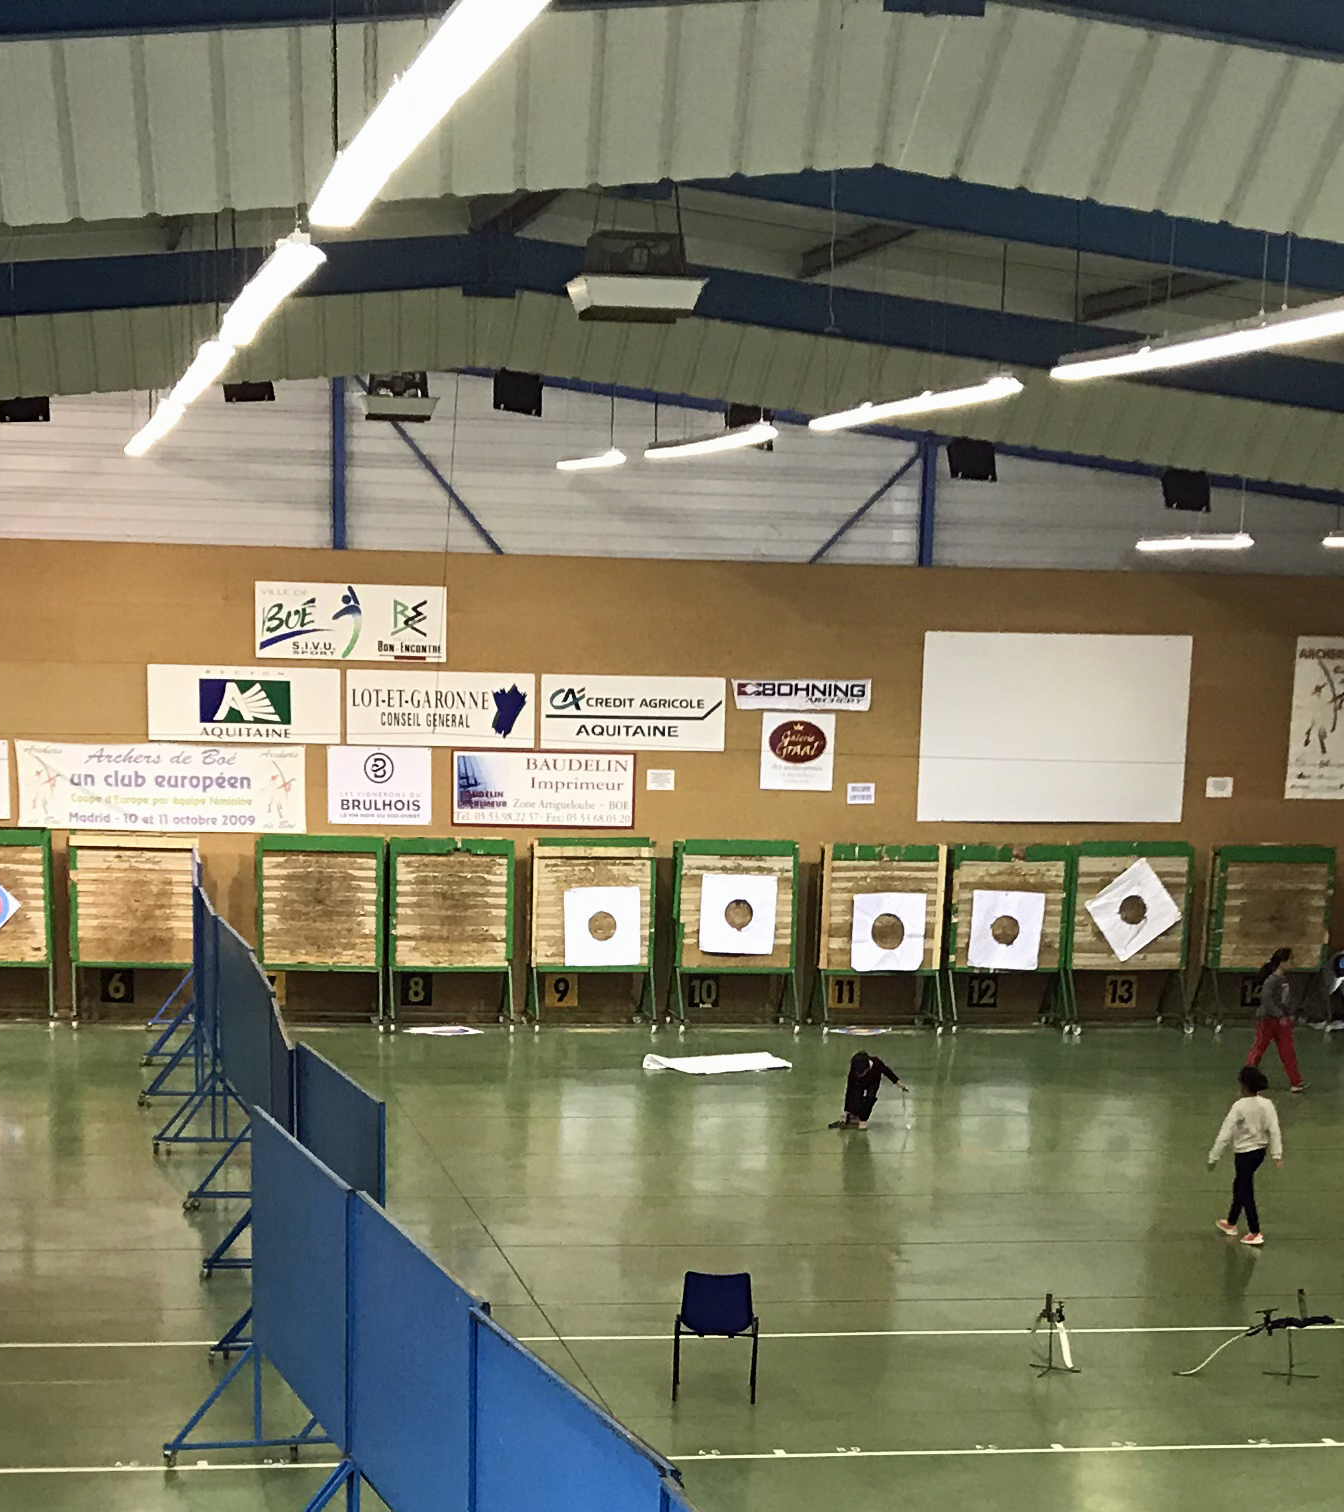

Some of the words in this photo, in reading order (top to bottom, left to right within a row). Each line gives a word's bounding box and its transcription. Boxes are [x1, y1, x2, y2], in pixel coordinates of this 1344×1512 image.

[761, 682, 866, 698] BOHNING
[585, 697, 635, 709] CREDIT
[639, 697, 705, 710] AGRICOLE
[380, 712, 422, 727] CONSEIL
[425, 713, 471, 729] GENERAL
[199, 726, 292, 739] AQUITAINE
[576, 724, 679, 738] AQUITAINE
[84, 747, 163, 765] Archers
[170, 750, 193, 765] de
[201, 748, 238, 766] Boé
[525, 757, 629, 773] BAUDELIN
[69, 773, 96, 787] un
[103, 770, 147, 788] club
[154, 772, 252, 793] européen
[530, 776, 625, 793] Imprimeur
[340, 799, 421, 811] BRULHOIS
[513, 799, 536, 809] Zone
[68, 812, 111, 824] Madrid
[123, 813, 139, 824] 10
[158, 814, 168, 825] 11
[173, 814, 218, 826] octobre
[221, 815, 256, 826] 2009
[108, 972, 126, 999] 6
[408, 976, 425, 1002] 8
[553, 977, 570, 1003] 9
[690, 979, 717, 1005] 10
[834, 979, 855, 1004] 11
[969, 978, 997, 1005] 12
[1108, 979, 1134, 1004] 13
